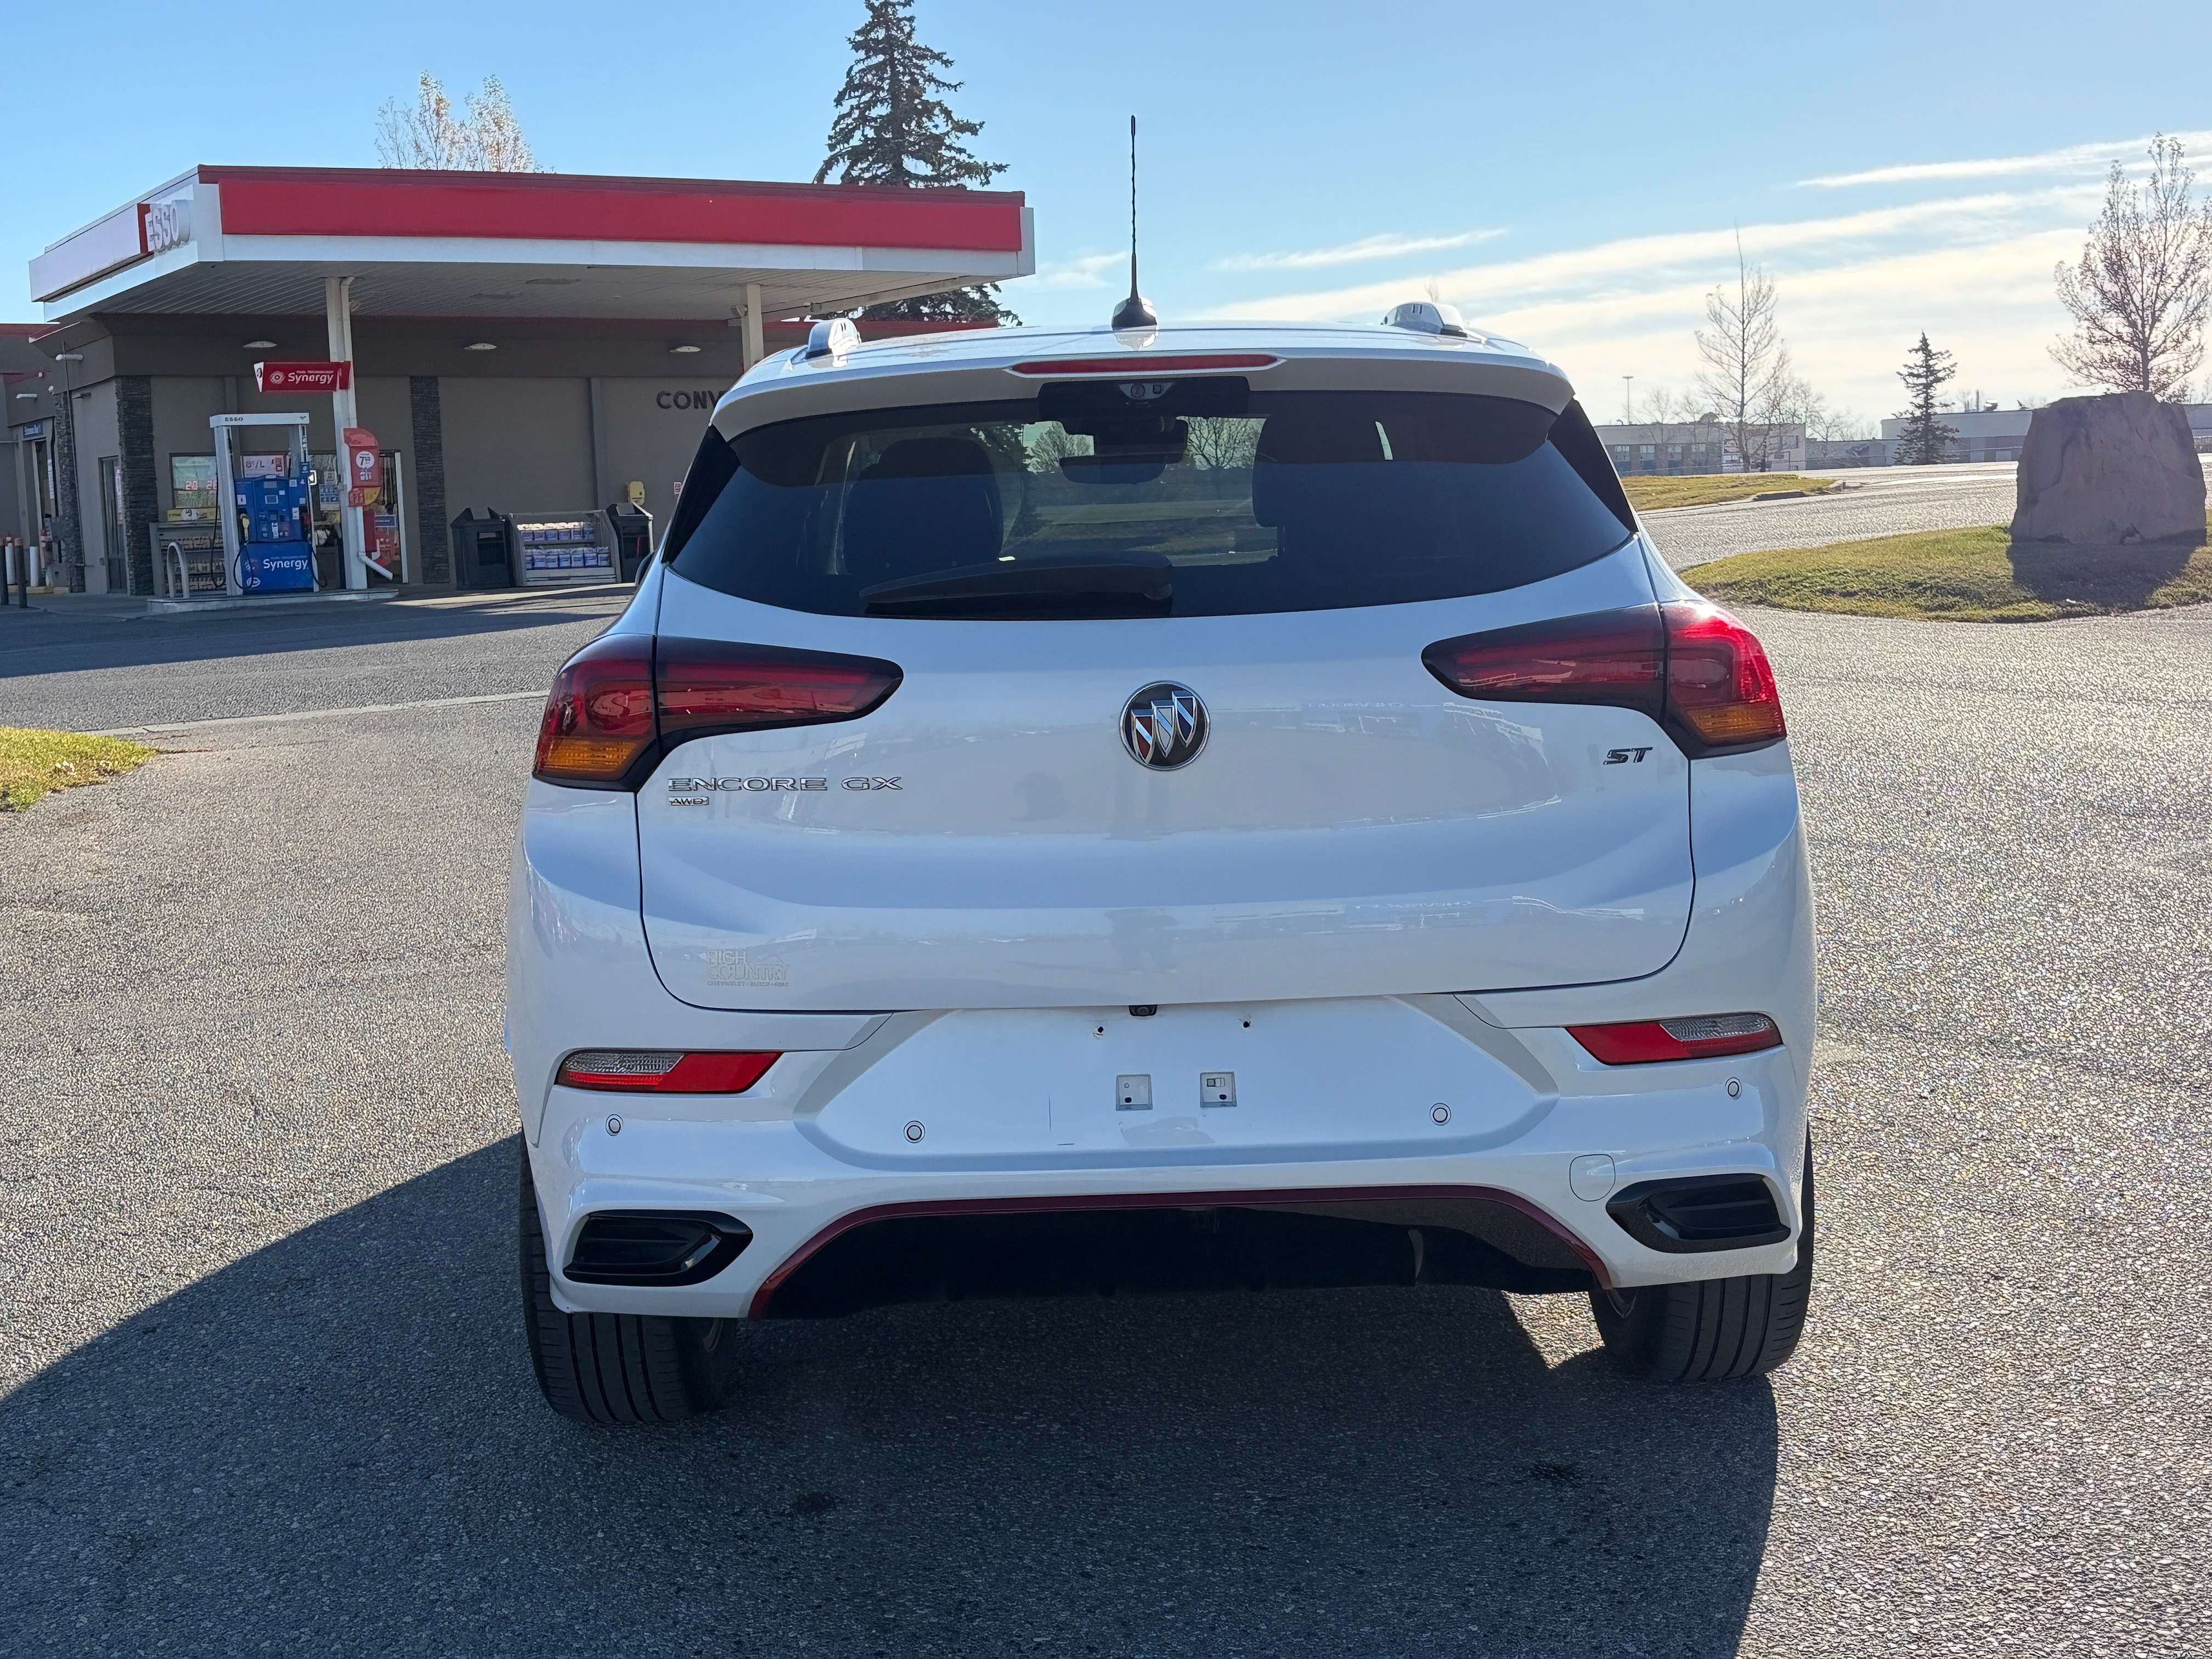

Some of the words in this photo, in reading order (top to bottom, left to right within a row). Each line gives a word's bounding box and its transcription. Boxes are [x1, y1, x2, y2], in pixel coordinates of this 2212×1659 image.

[288, 373, 334, 384] Synergy
[263, 558, 308, 571] Synergy
[1603, 747, 1654, 765] ST
[668, 777, 828, 791] ENCORE
[841, 776, 903, 791] GX
[668, 796, 709, 806] AWD
